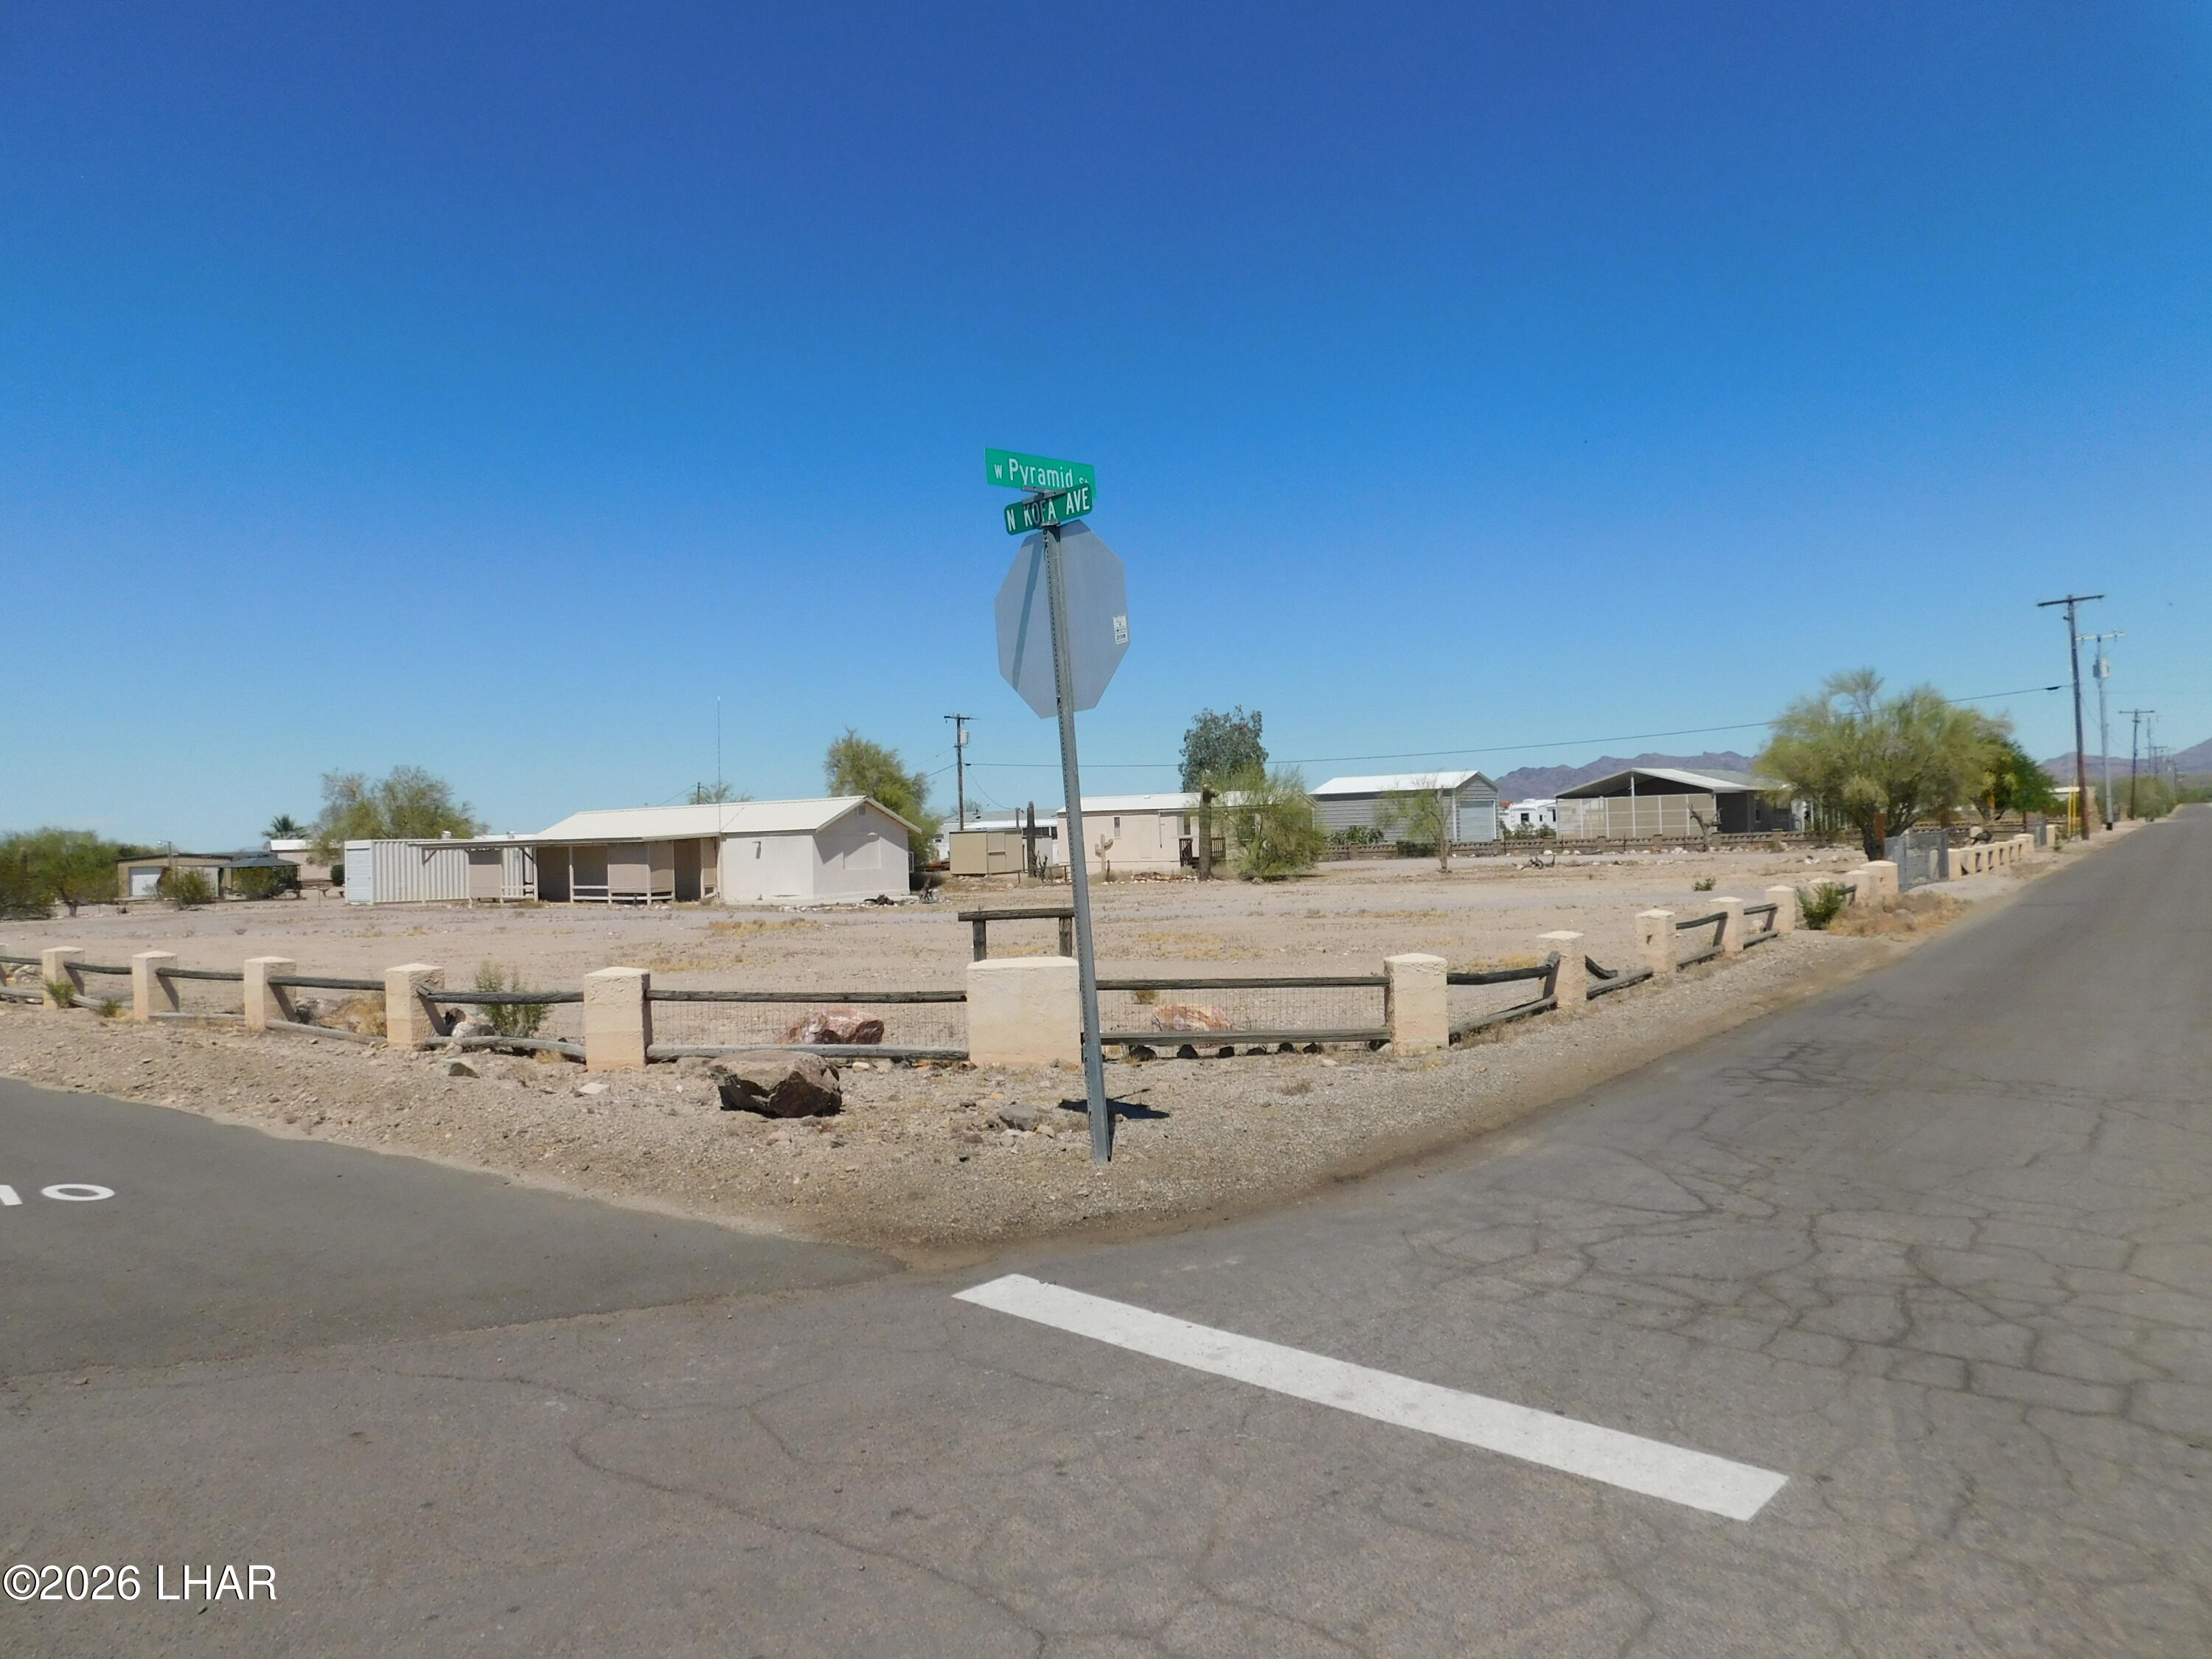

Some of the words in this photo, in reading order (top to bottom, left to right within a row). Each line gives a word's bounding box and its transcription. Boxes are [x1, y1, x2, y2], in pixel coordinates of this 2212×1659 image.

[1009, 458, 1074, 488] Pyramid
[1006, 509, 1016, 532] N
[1023, 498, 1057, 527] KOFA
[1066, 487, 1090, 515] AVE
